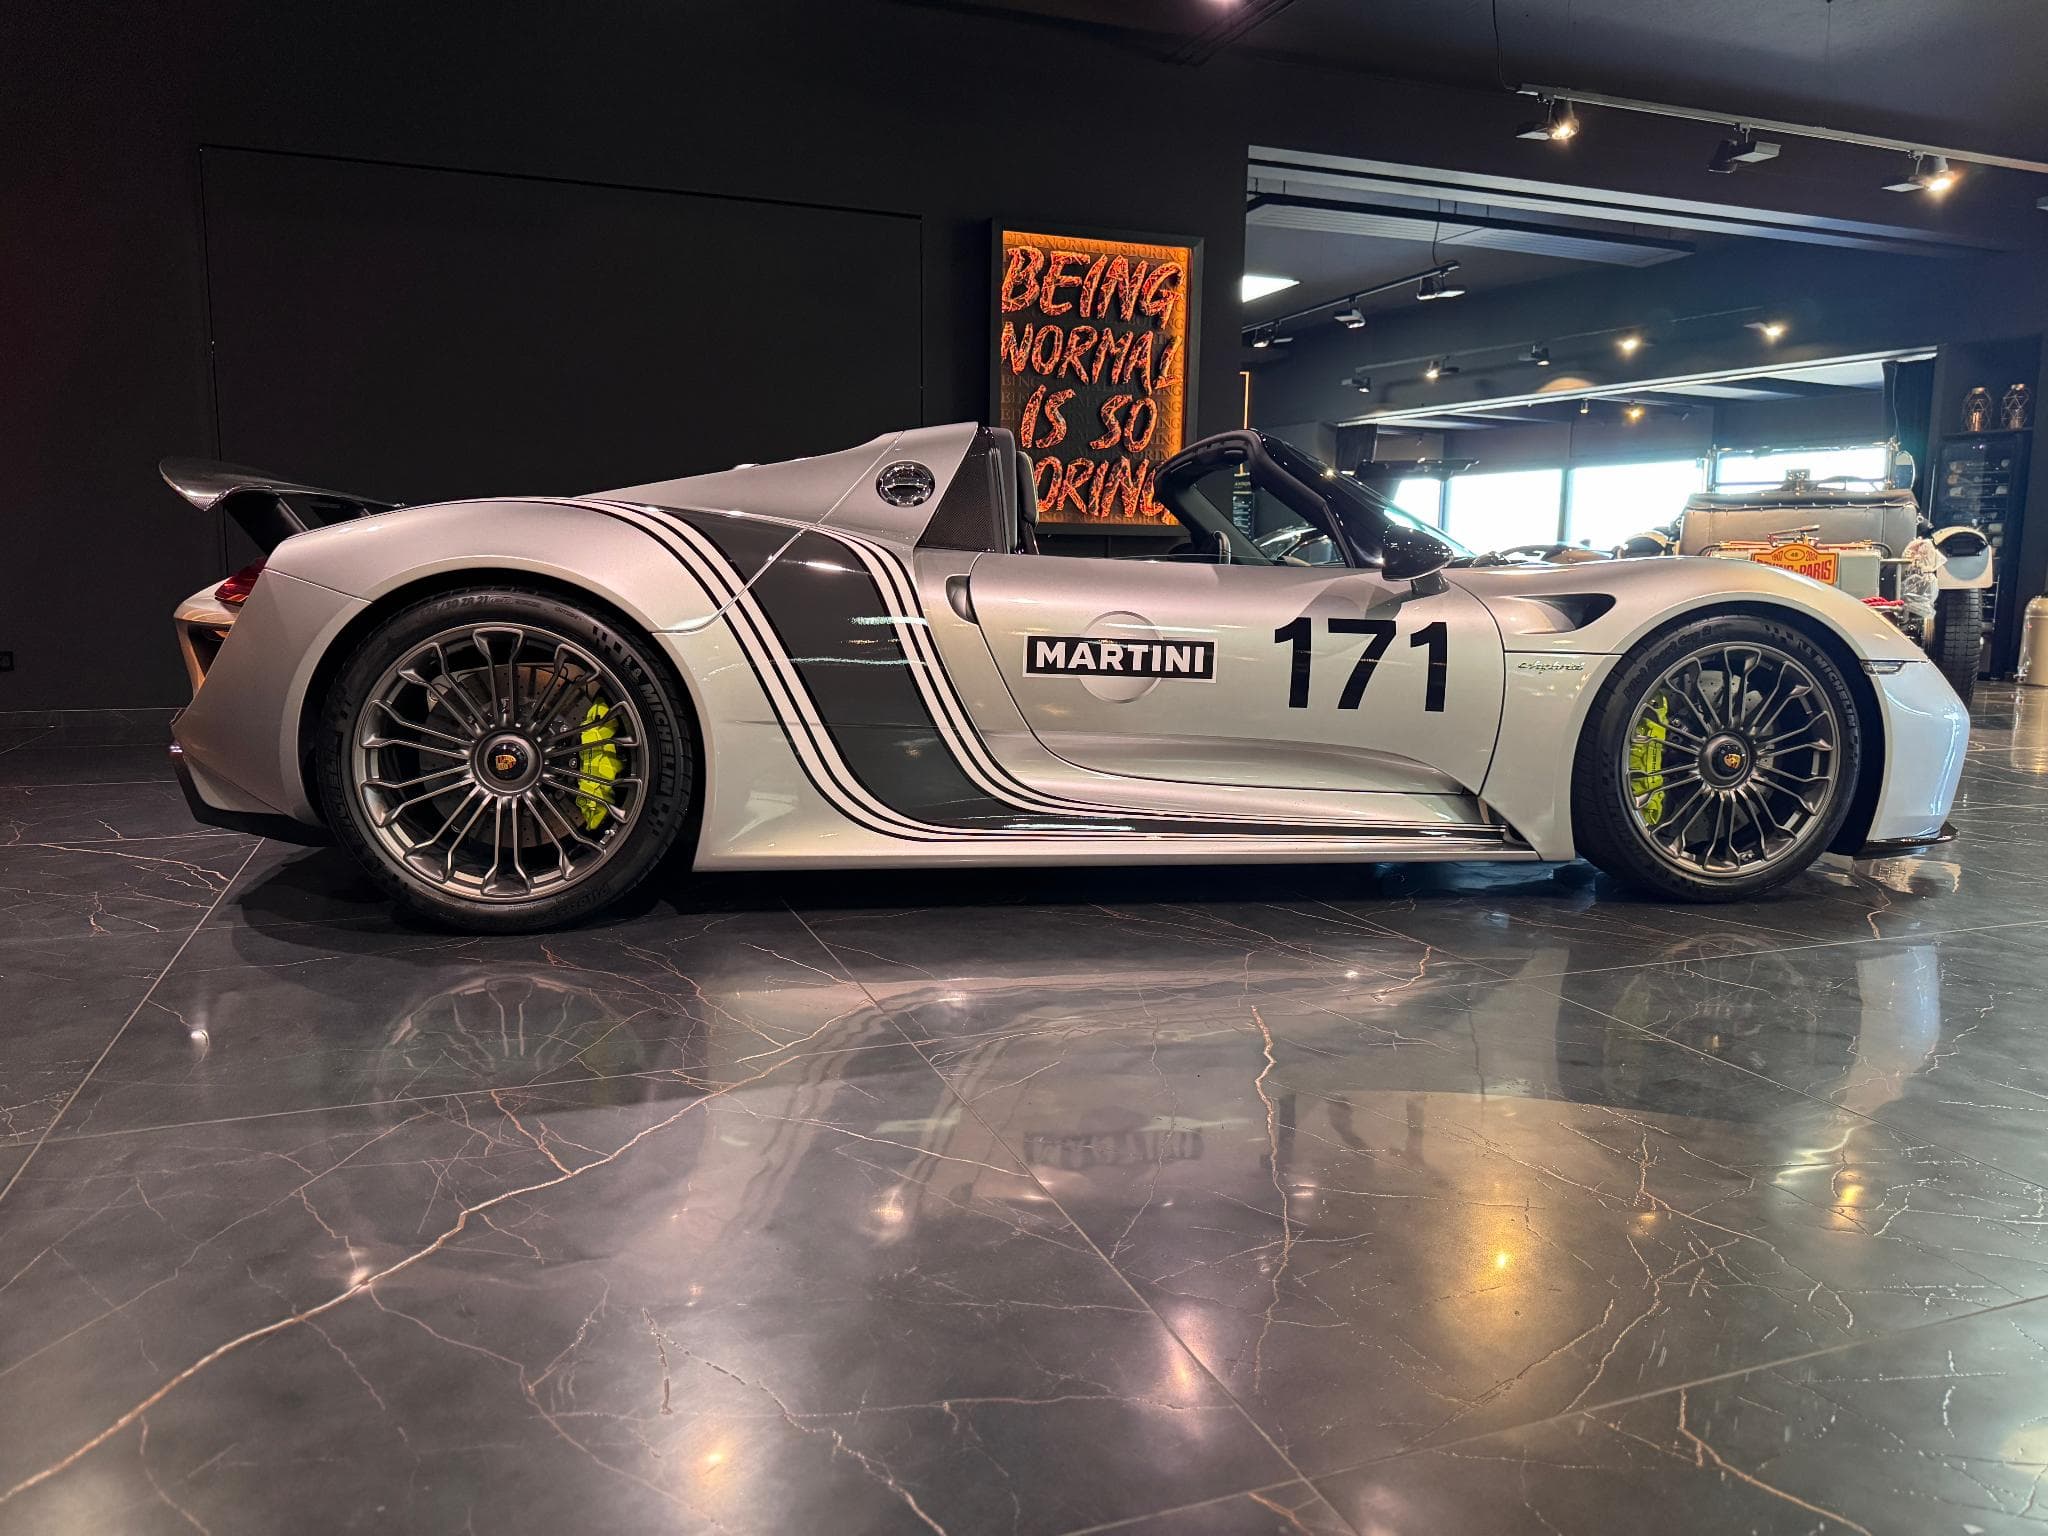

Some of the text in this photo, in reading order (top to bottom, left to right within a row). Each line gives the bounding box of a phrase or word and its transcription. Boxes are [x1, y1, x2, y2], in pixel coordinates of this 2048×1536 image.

[1002, 245, 1184, 329] BEING
[1001, 321, 1184, 396] NORMAL
[1021, 384, 1076, 448] IS
[1089, 394, 1157, 452] SO
[1034, 455, 1179, 525] ORING
[1800, 559, 1832, 580] PARIS
[1036, 641, 1205, 673] MARTINI
[1275, 617, 1447, 712] 171
[1815, 654, 1857, 728] MICHELIN
[639, 682, 676, 797] MICHELIN
